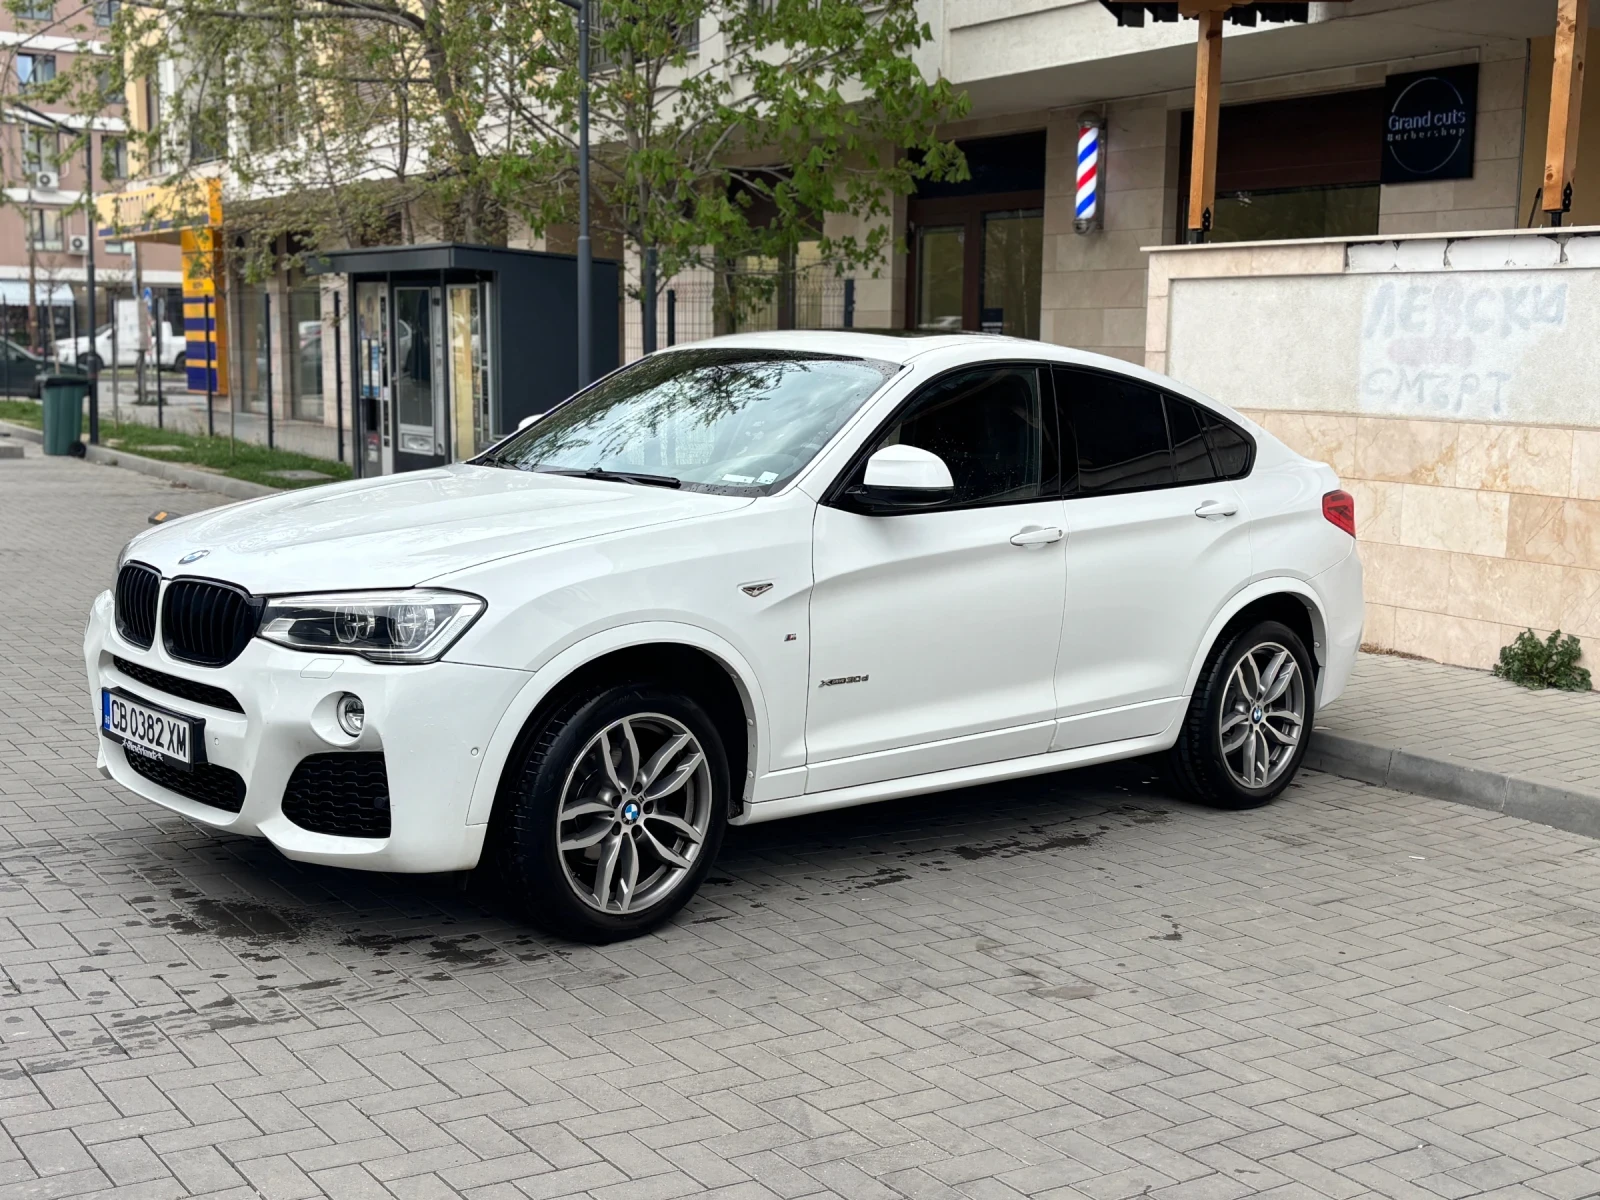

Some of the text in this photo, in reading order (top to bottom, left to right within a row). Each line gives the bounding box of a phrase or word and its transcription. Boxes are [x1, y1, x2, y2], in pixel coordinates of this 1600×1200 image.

[1388, 109, 1466, 131] Grand cuts
[1387, 127, 1465, 141] Barbershop
[130, 707, 165, 749] 0382
